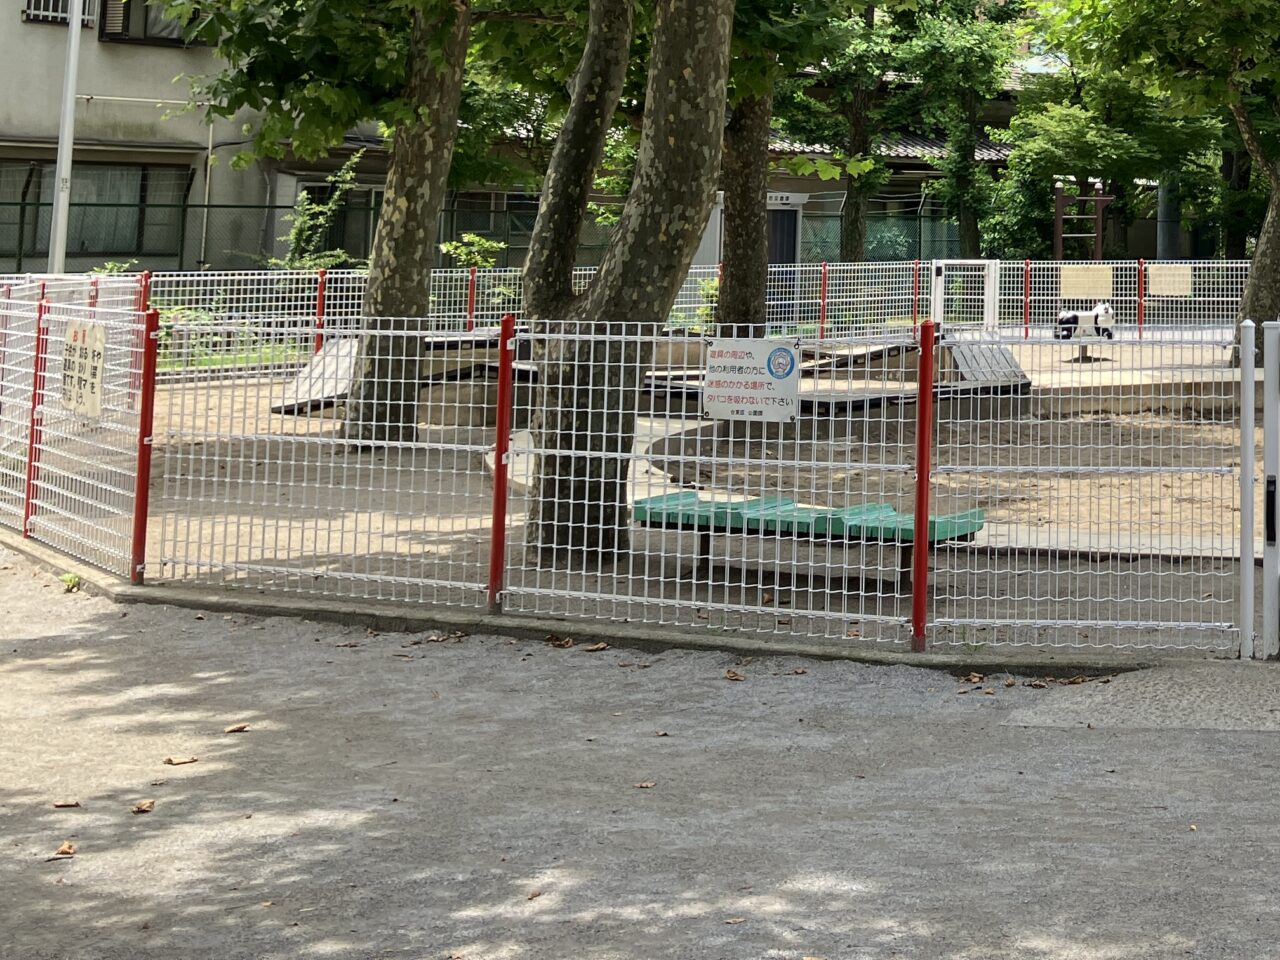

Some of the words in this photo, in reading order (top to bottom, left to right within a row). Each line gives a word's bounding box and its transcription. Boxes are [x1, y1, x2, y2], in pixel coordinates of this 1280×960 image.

[706, 395, 794, 407] タバコを吸わないで下さい
